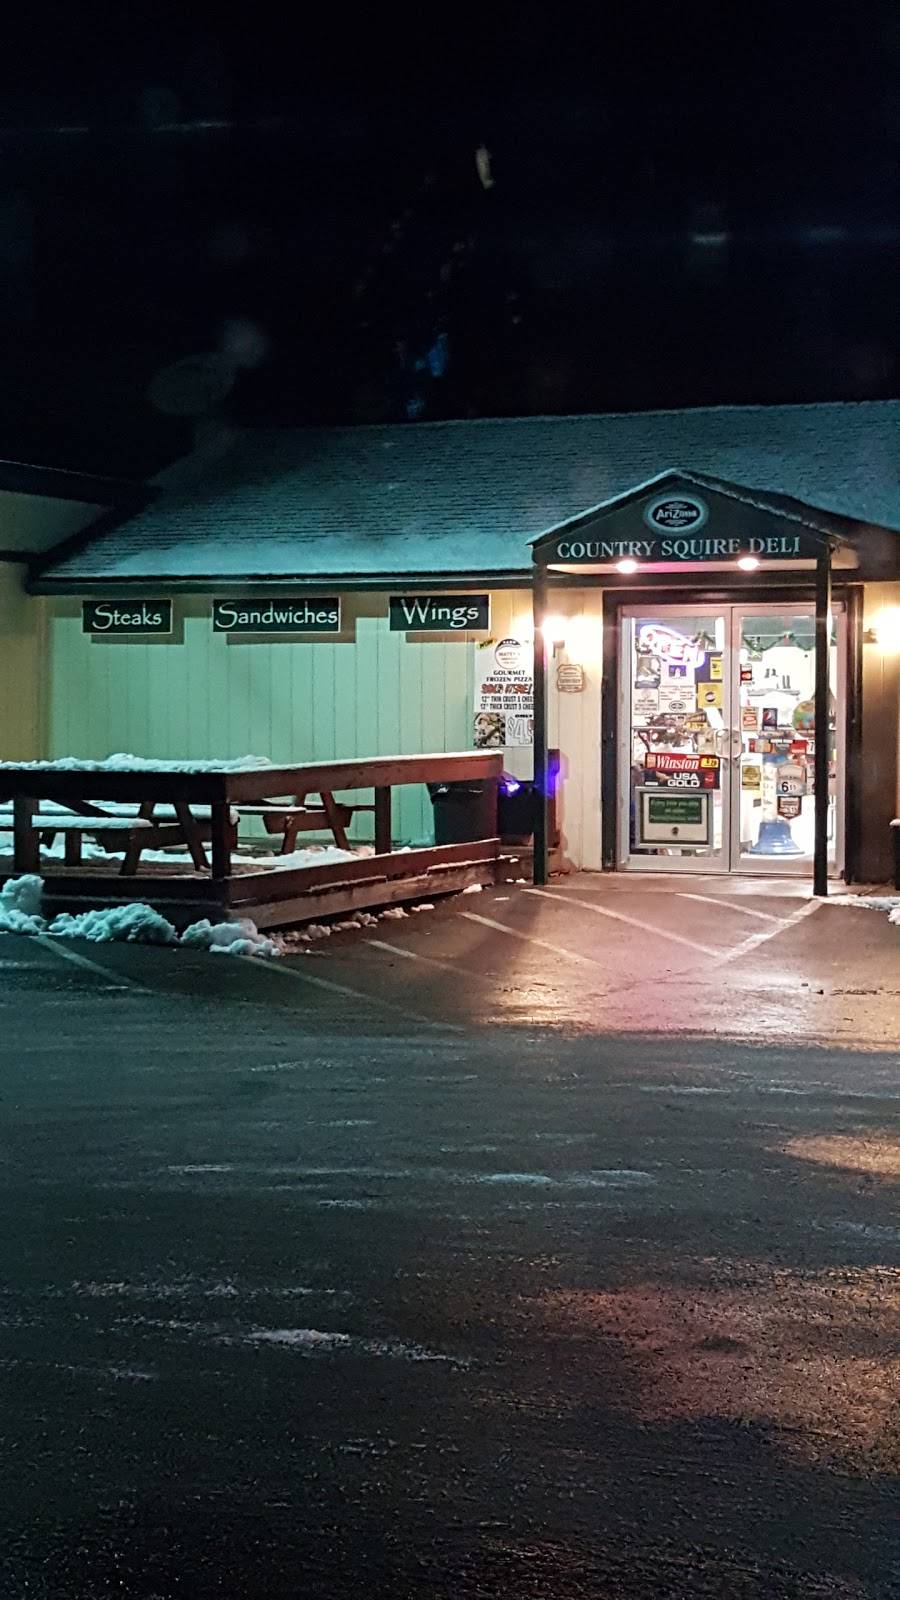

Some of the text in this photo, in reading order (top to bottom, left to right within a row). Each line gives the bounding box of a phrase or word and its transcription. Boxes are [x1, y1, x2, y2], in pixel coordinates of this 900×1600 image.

[557, 536, 801, 558] COUNTRY SQUIRE DELI
[91, 604, 163, 630] Steaks
[215, 602, 339, 629] Sandwiches
[400, 598, 480, 628] Wings
[656, 755, 700, 770] Winston
[667, 779, 700, 788] GOLD
[673, 772, 699, 780] USA
